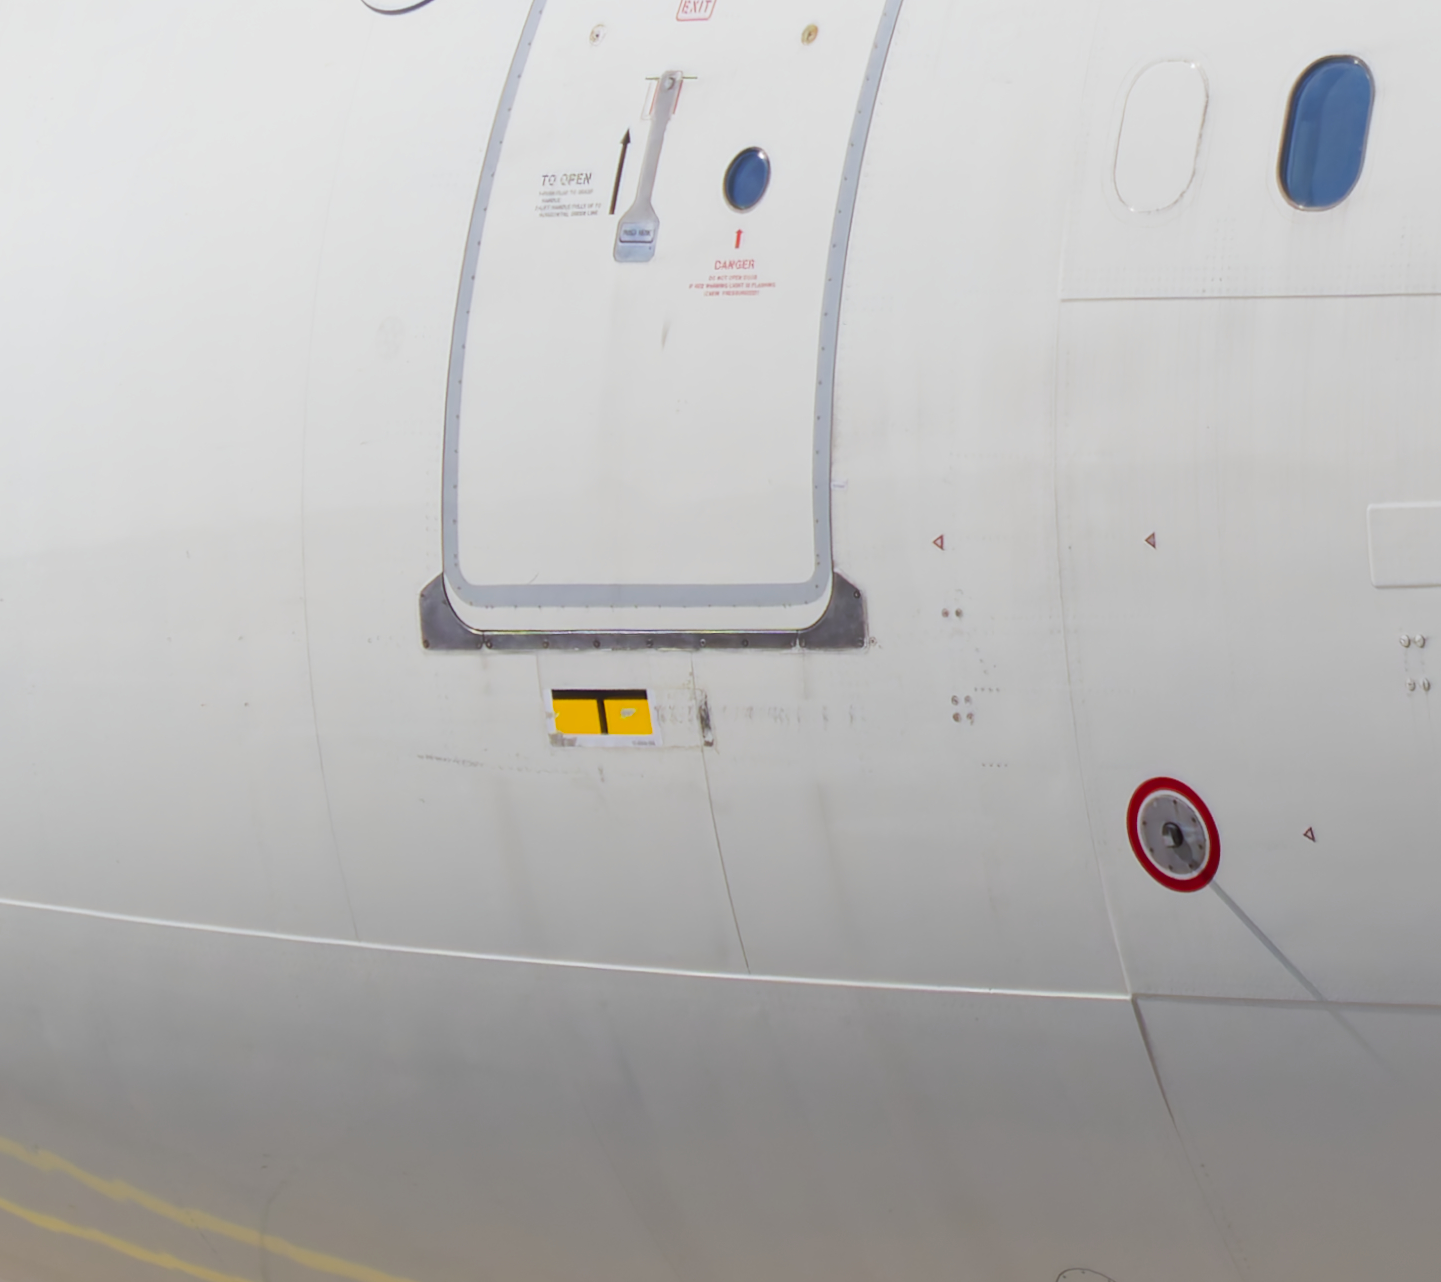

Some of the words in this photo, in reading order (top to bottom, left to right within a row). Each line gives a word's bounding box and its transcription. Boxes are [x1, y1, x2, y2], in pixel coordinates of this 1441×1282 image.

[682, 0, 712, 14] EXIT
[542, 175, 556, 186] TO
[560, 173, 592, 185] OPEN
[715, 259, 754, 270] DANGER
